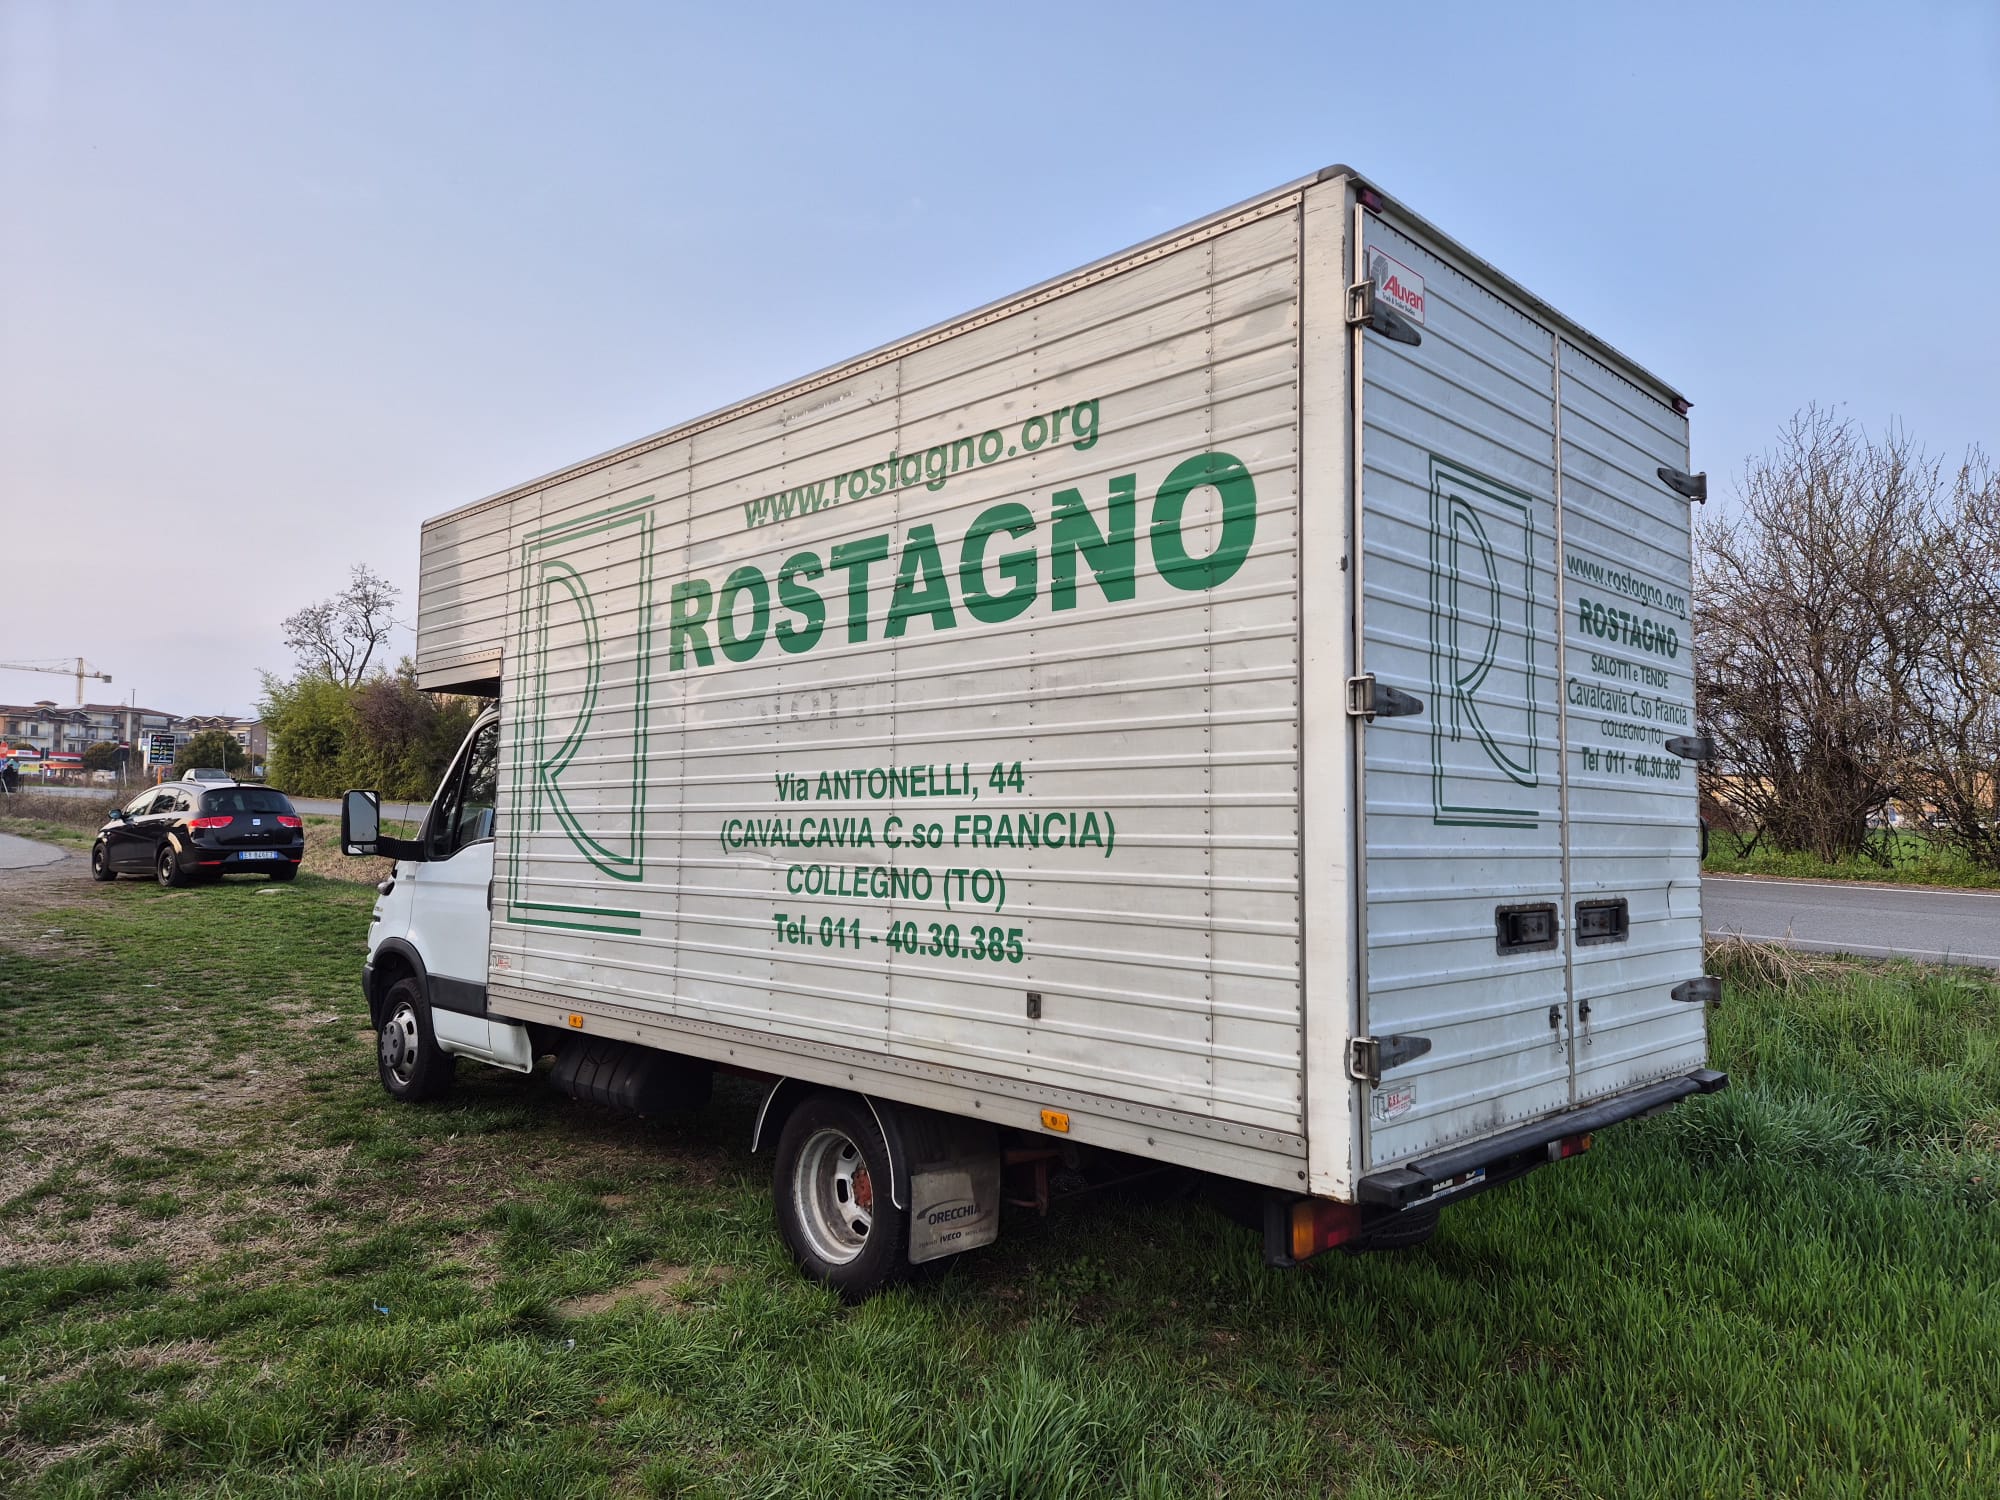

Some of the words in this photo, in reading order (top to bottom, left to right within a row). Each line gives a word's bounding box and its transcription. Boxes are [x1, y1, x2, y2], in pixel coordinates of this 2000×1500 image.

[1383, 275, 1424, 312] Aluvan
[743, 397, 1100, 529] www.rostagno.org
[669, 451, 1257, 671] ROSTAGNO
[1566, 553, 1686, 620] www.rostagno.org
[1578, 597, 1679, 659] ROSTAGNO
[1591, 654, 1631, 680] SALOTTI
[1633, 670, 1638, 681] e
[1640, 665, 1669, 689] TENDE
[1567, 677, 1628, 714] Cavalcavia
[1631, 691, 1652, 719] C.so
[1655, 697, 1688, 726] Francia
[1601, 719, 1646, 742] COLLEGNO
[1648, 727, 1664, 745] (TO)
[775, 773, 809, 801] Via
[815, 763, 979, 801] ANTONELLI,
[988, 761, 1025, 794] 44
[1606, 750, 1626, 774] 011
[1634, 754, 1682, 780] 40.30.385
[719, 817, 876, 856] (CAVALCAVIA
[882, 816, 944, 849] C.so
[953, 811, 1116, 858] FRANCIA)
[786, 864, 933, 901] COLLEGNO
[943, 868, 1007, 913] (TO)
[773, 913, 813, 945] Tel.
[819, 916, 861, 950] 011
[886, 921, 1024, 964] 40.30.385
[940, 1231, 961, 1244] IVECO
